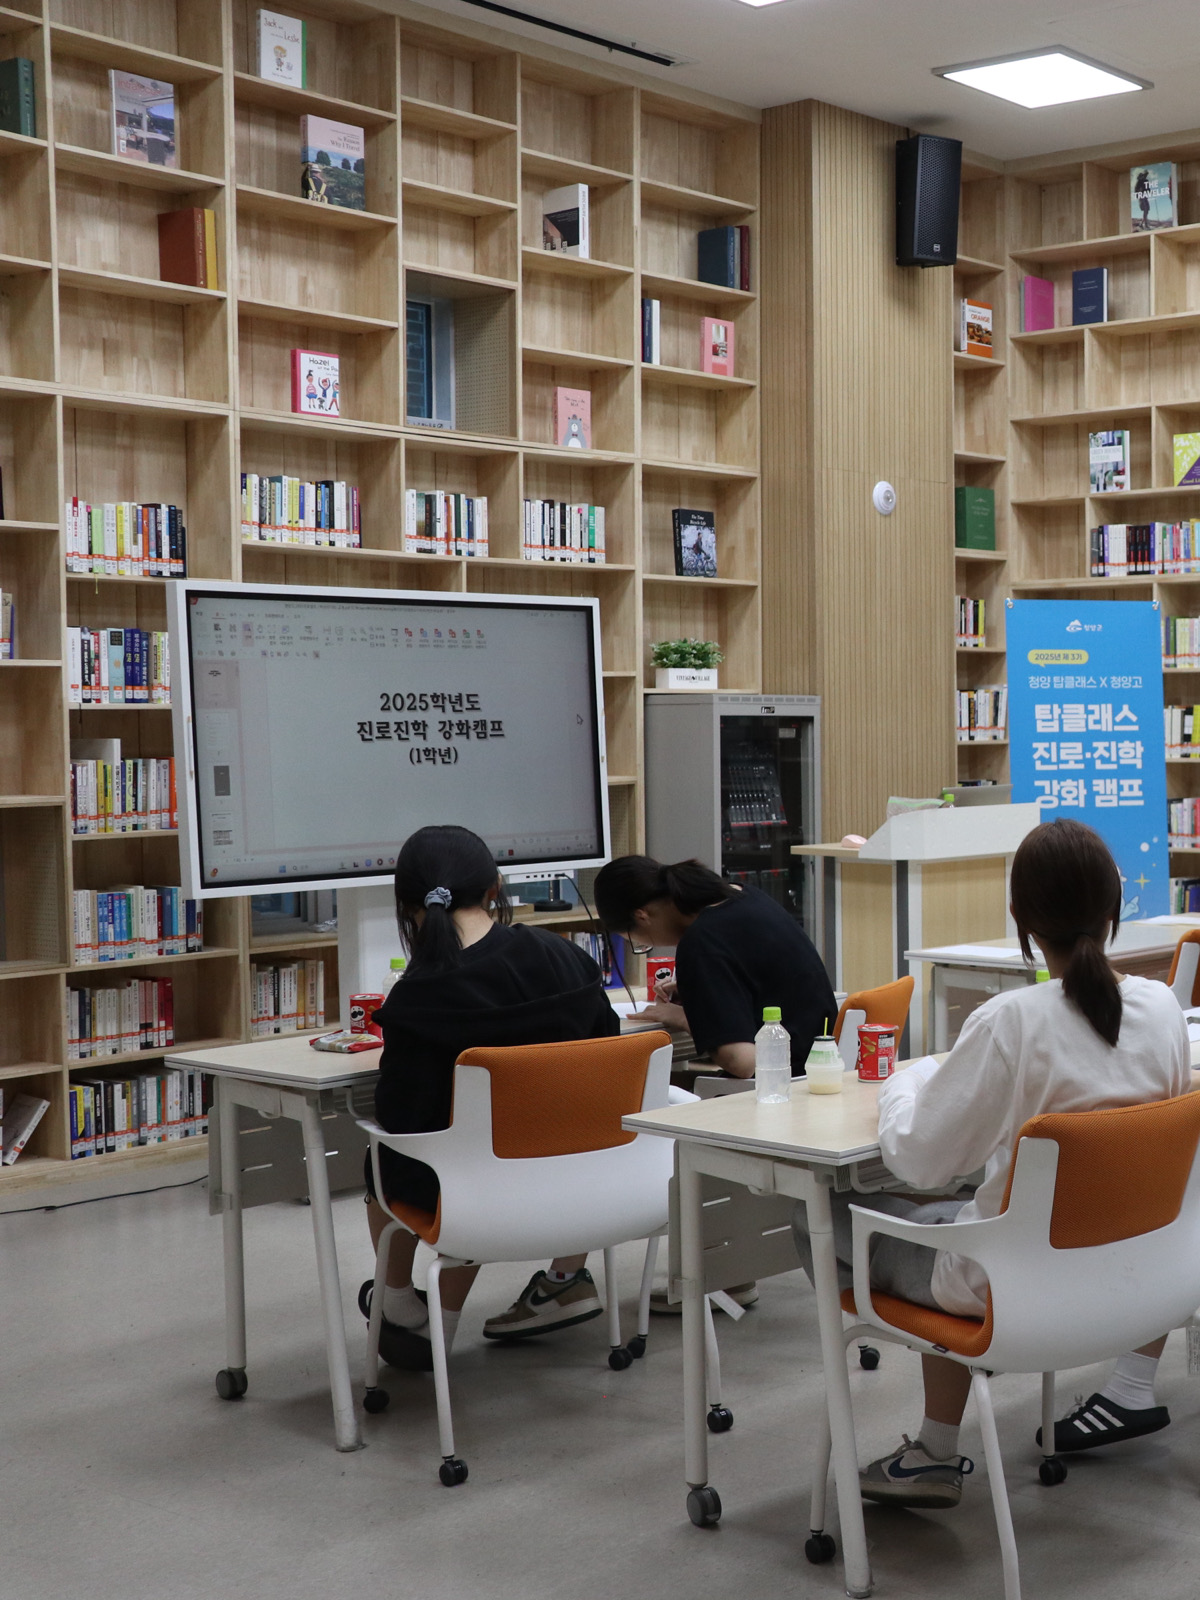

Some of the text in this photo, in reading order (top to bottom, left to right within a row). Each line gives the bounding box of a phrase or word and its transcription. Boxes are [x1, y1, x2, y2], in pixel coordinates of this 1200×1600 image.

[1143, 180, 1159, 190] THE
[1132, 187, 1170, 200] TRAVELER
[308, 356, 330, 367] Hazel
[1083, 624, 1103, 632] 청양군
[1034, 653, 1083, 661] 2025년 제 3기
[1028, 676, 1143, 689] 청양 탑클래스 X 청양고
[380, 692, 482, 713] 2025학년도
[1034, 703, 1140, 733] 탑클래스
[356, 719, 506, 742] 진로진학 강화캠프
[408, 746, 459, 766] (1학년)
[1032, 740, 1144, 771] 진로·진학
[1033, 778, 1145, 809] 강화 캠프
